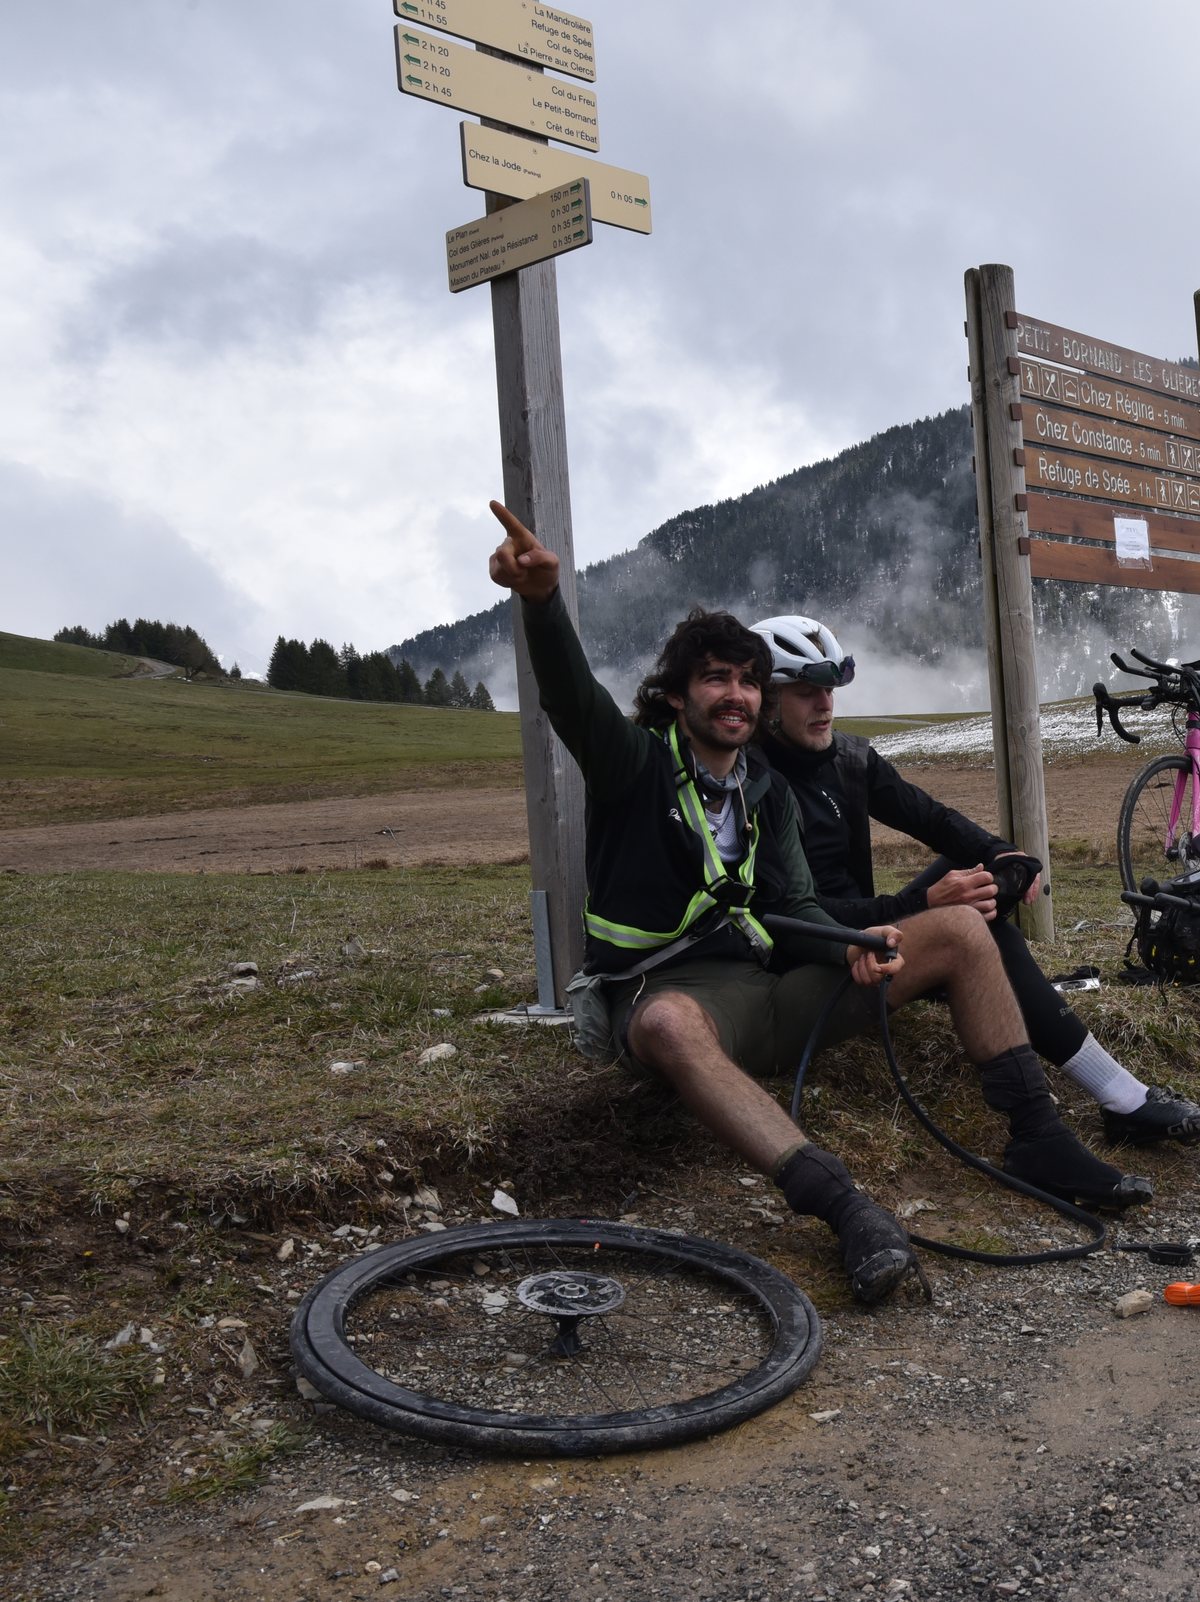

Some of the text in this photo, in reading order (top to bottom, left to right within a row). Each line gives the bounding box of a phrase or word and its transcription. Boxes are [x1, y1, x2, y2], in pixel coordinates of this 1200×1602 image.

[420, 10, 448, 26] 1 h 55
[534, 6, 544, 16] La
[531, 19, 592, 48] Refuge de Spée
[422, 40, 449, 57] 2 h 20
[546, 40, 593, 62] Col de Spée
[423, 60, 450, 78] 2 h 20
[518, 44, 594, 76] La Pierre aux Clercs
[424, 81, 452, 98] 2 h 45
[552, 86, 596, 108] Col du Freu
[532, 97, 597, 126] Le Petit-Bornand
[546, 120, 563, 133] Crêt
[564, 128, 574, 137] de
[468, 149, 490, 163] Chez
[492, 155, 500, 166] la
[502, 159, 522, 172] Jode
[550, 190, 570, 203] 150 m
[610, 190, 616, 199] 0
[624, 194, 633, 204] 05
[550, 204, 570, 218] 0 h 30
[456, 230, 468, 240] Plan
[552, 219, 571, 234] 0 h 35
[448, 247, 458, 258] Col
[460, 244, 470, 254] des
[470, 236, 490, 250] Glières
[552, 234, 572, 248] 0 h 35
[450, 255, 479, 273] Monument
[492, 247, 500, 257] de
[500, 244, 506, 254] la
[506, 232, 538, 251] Résistance
[450, 263, 501, 287] Maison du Plateau
[1016, 322, 1050, 352] PETIT
[1062, 336, 1122, 374] BORNAND
[1132, 360, 1152, 384] LES
[1081, 381, 1113, 410] Chez
[1116, 391, 1154, 422] Régina
[1164, 410, 1170, 424] 5
[1171, 414, 1188, 430] min.
[1036, 413, 1069, 442] Chez
[1072, 421, 1132, 456] Constance
[1140, 442, 1146, 458] 5
[1147, 446, 1164, 462] min.
[1039, 456, 1082, 490] Refuge
[1085, 466, 1100, 489] de
[1102, 470, 1130, 494] Spée
[1139, 482, 1144, 497] 1
